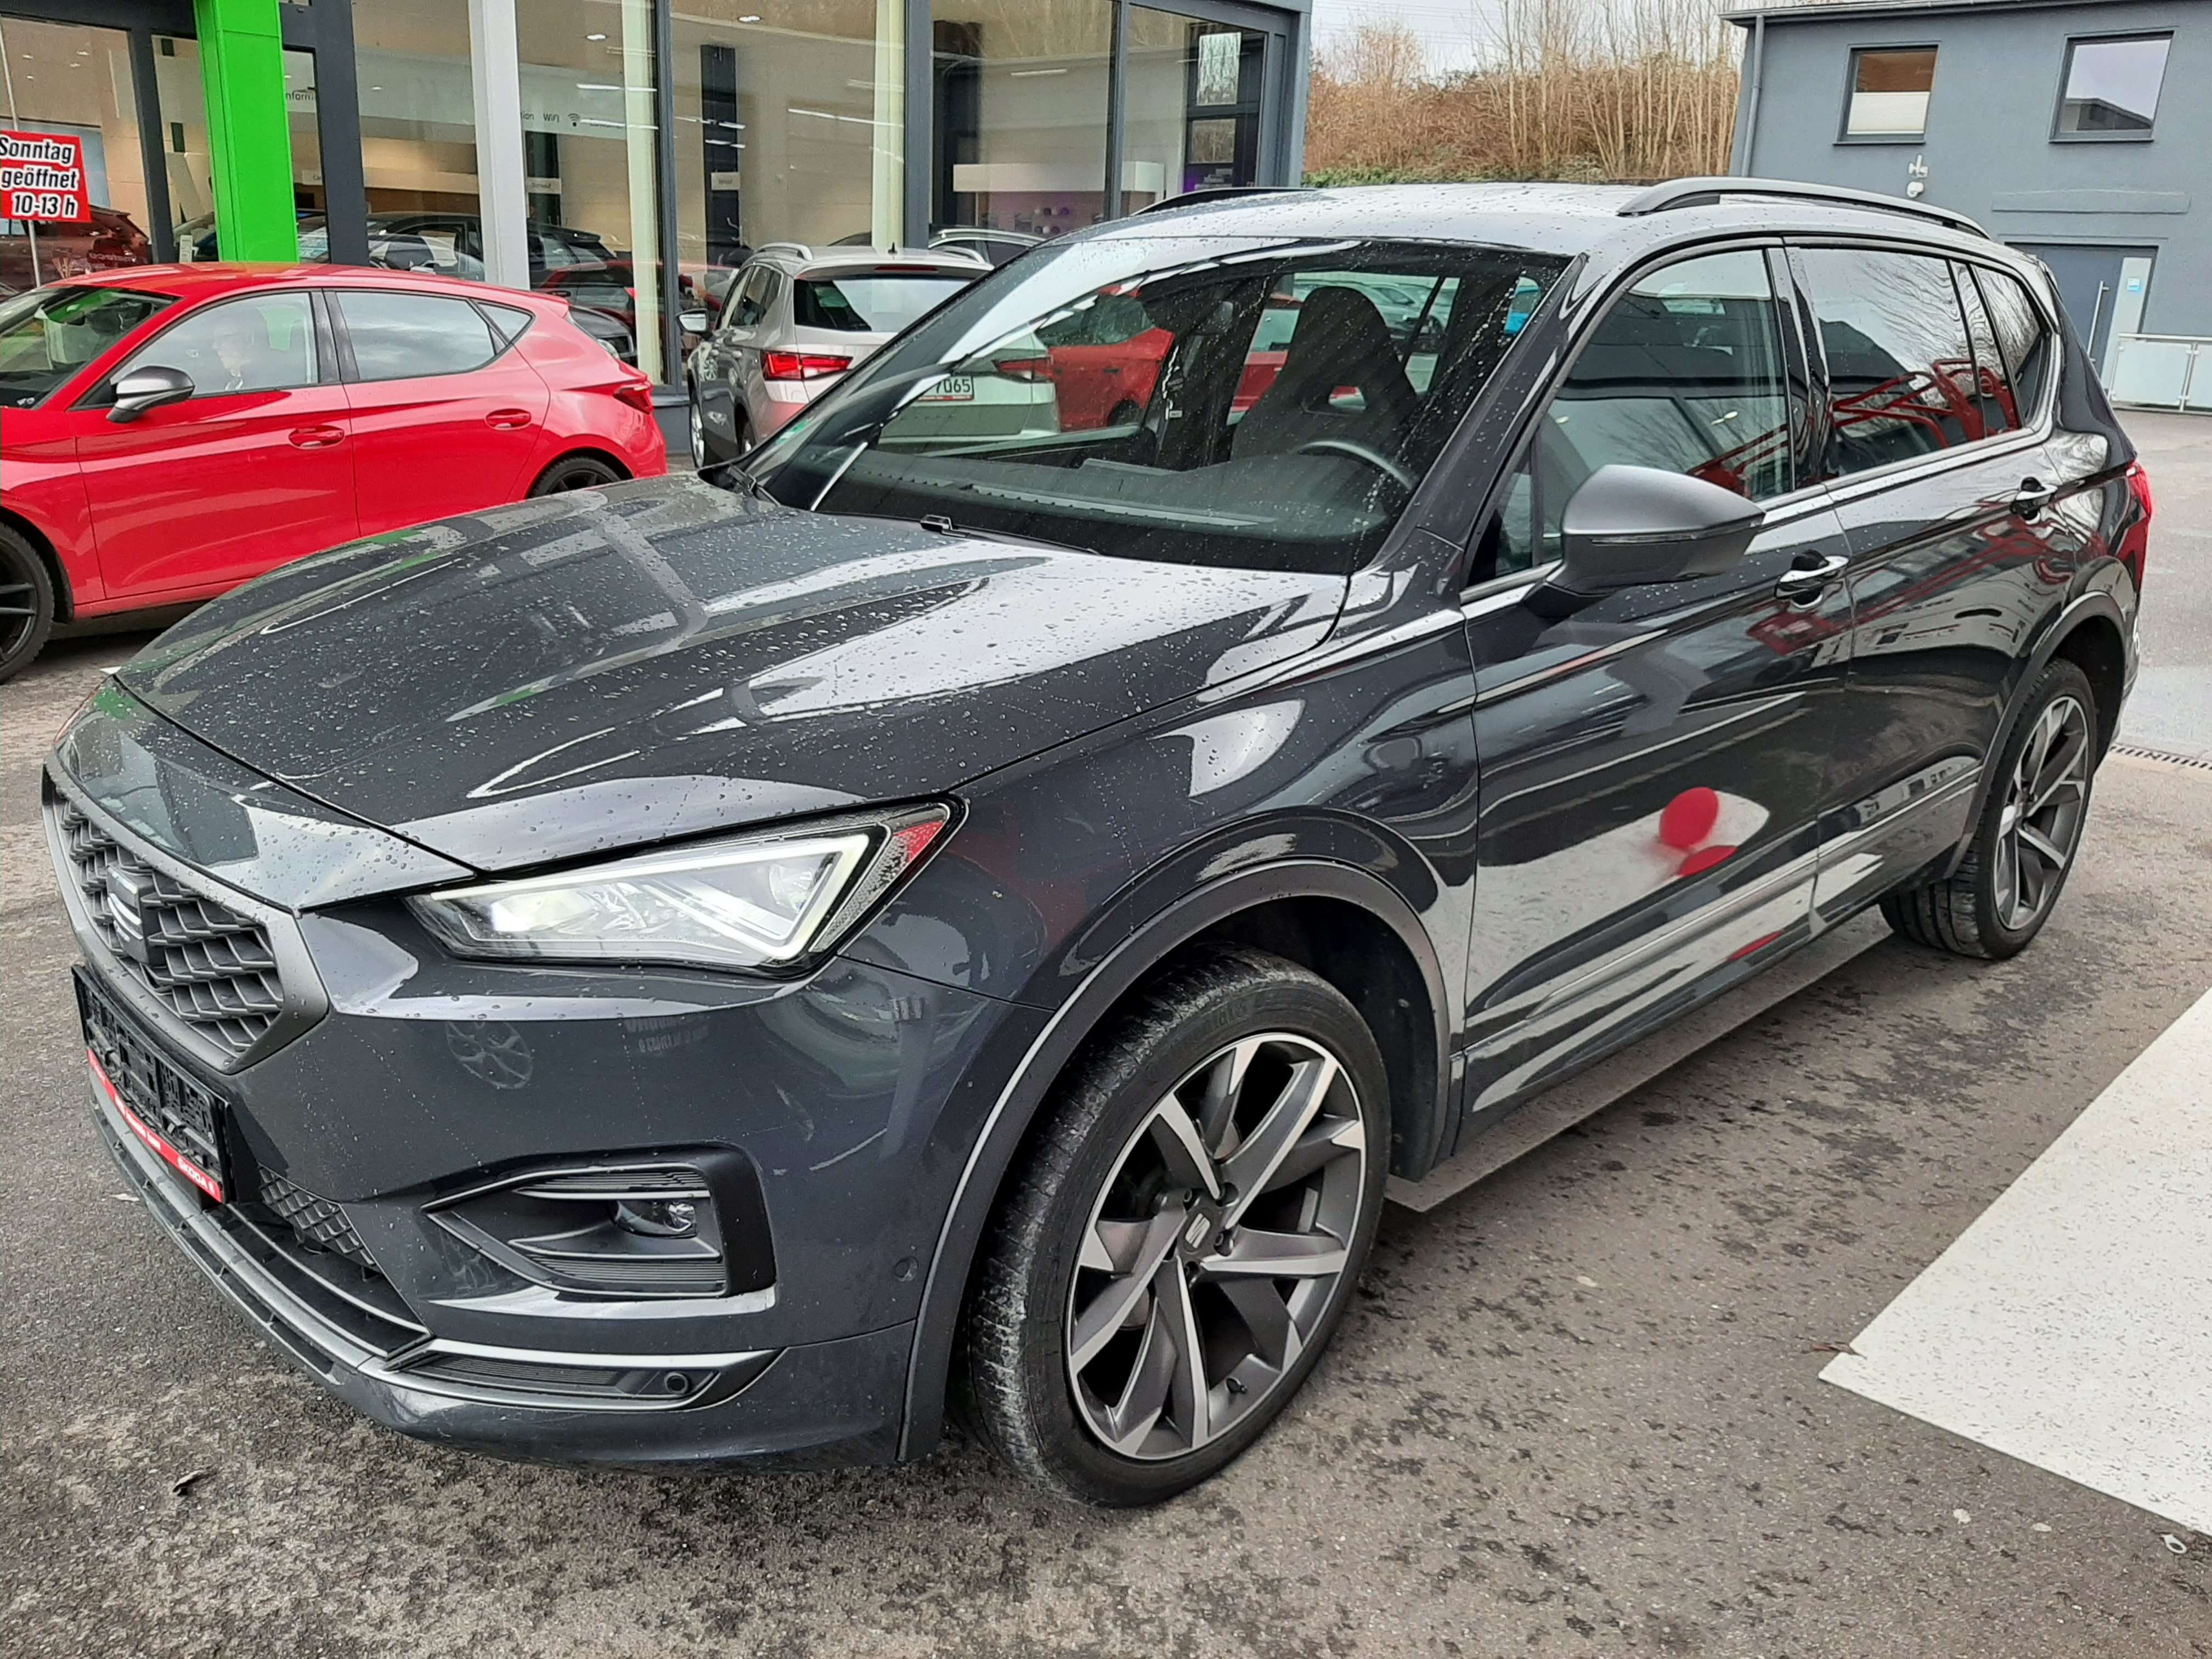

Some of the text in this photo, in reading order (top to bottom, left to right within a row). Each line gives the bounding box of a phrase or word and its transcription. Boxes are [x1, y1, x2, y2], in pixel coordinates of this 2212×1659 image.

[0, 137, 72, 164] Sonntag
[1, 167, 77, 189] geöffnet
[15, 194, 76, 216] 10-13 h
